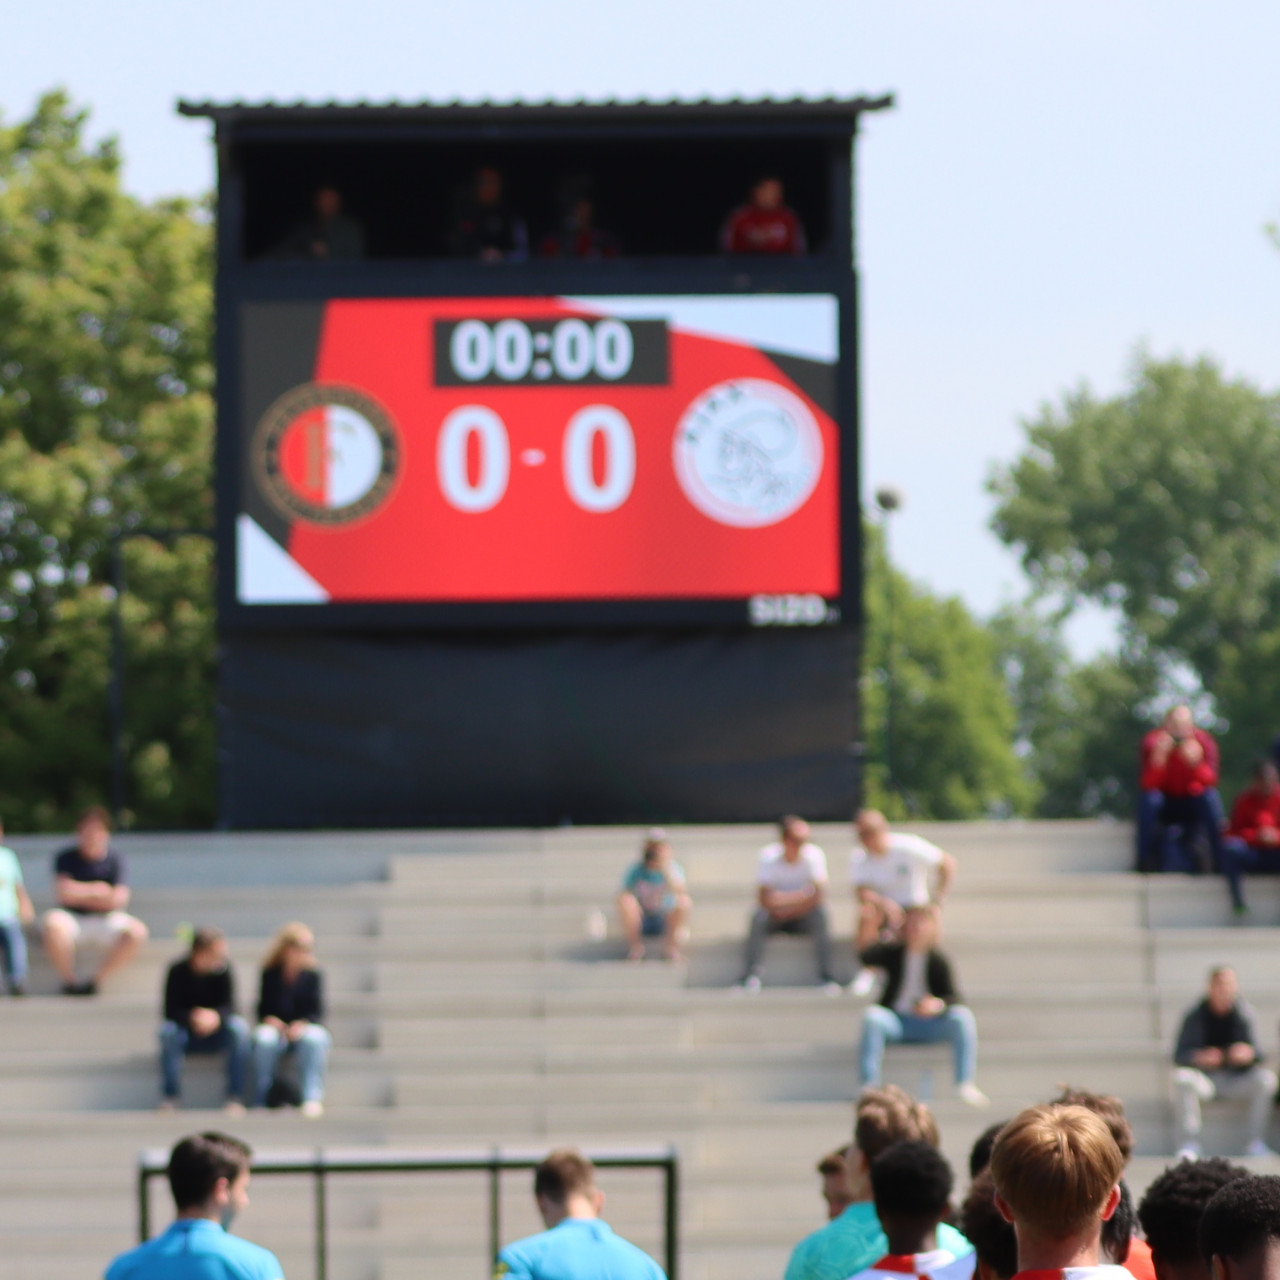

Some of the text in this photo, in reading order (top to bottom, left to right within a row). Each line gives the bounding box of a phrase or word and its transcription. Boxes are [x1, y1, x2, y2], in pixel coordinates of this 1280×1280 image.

[450, 318, 634, 382] 00:00
[436, 404, 510, 514] 0
[562, 403, 636, 514] 0
